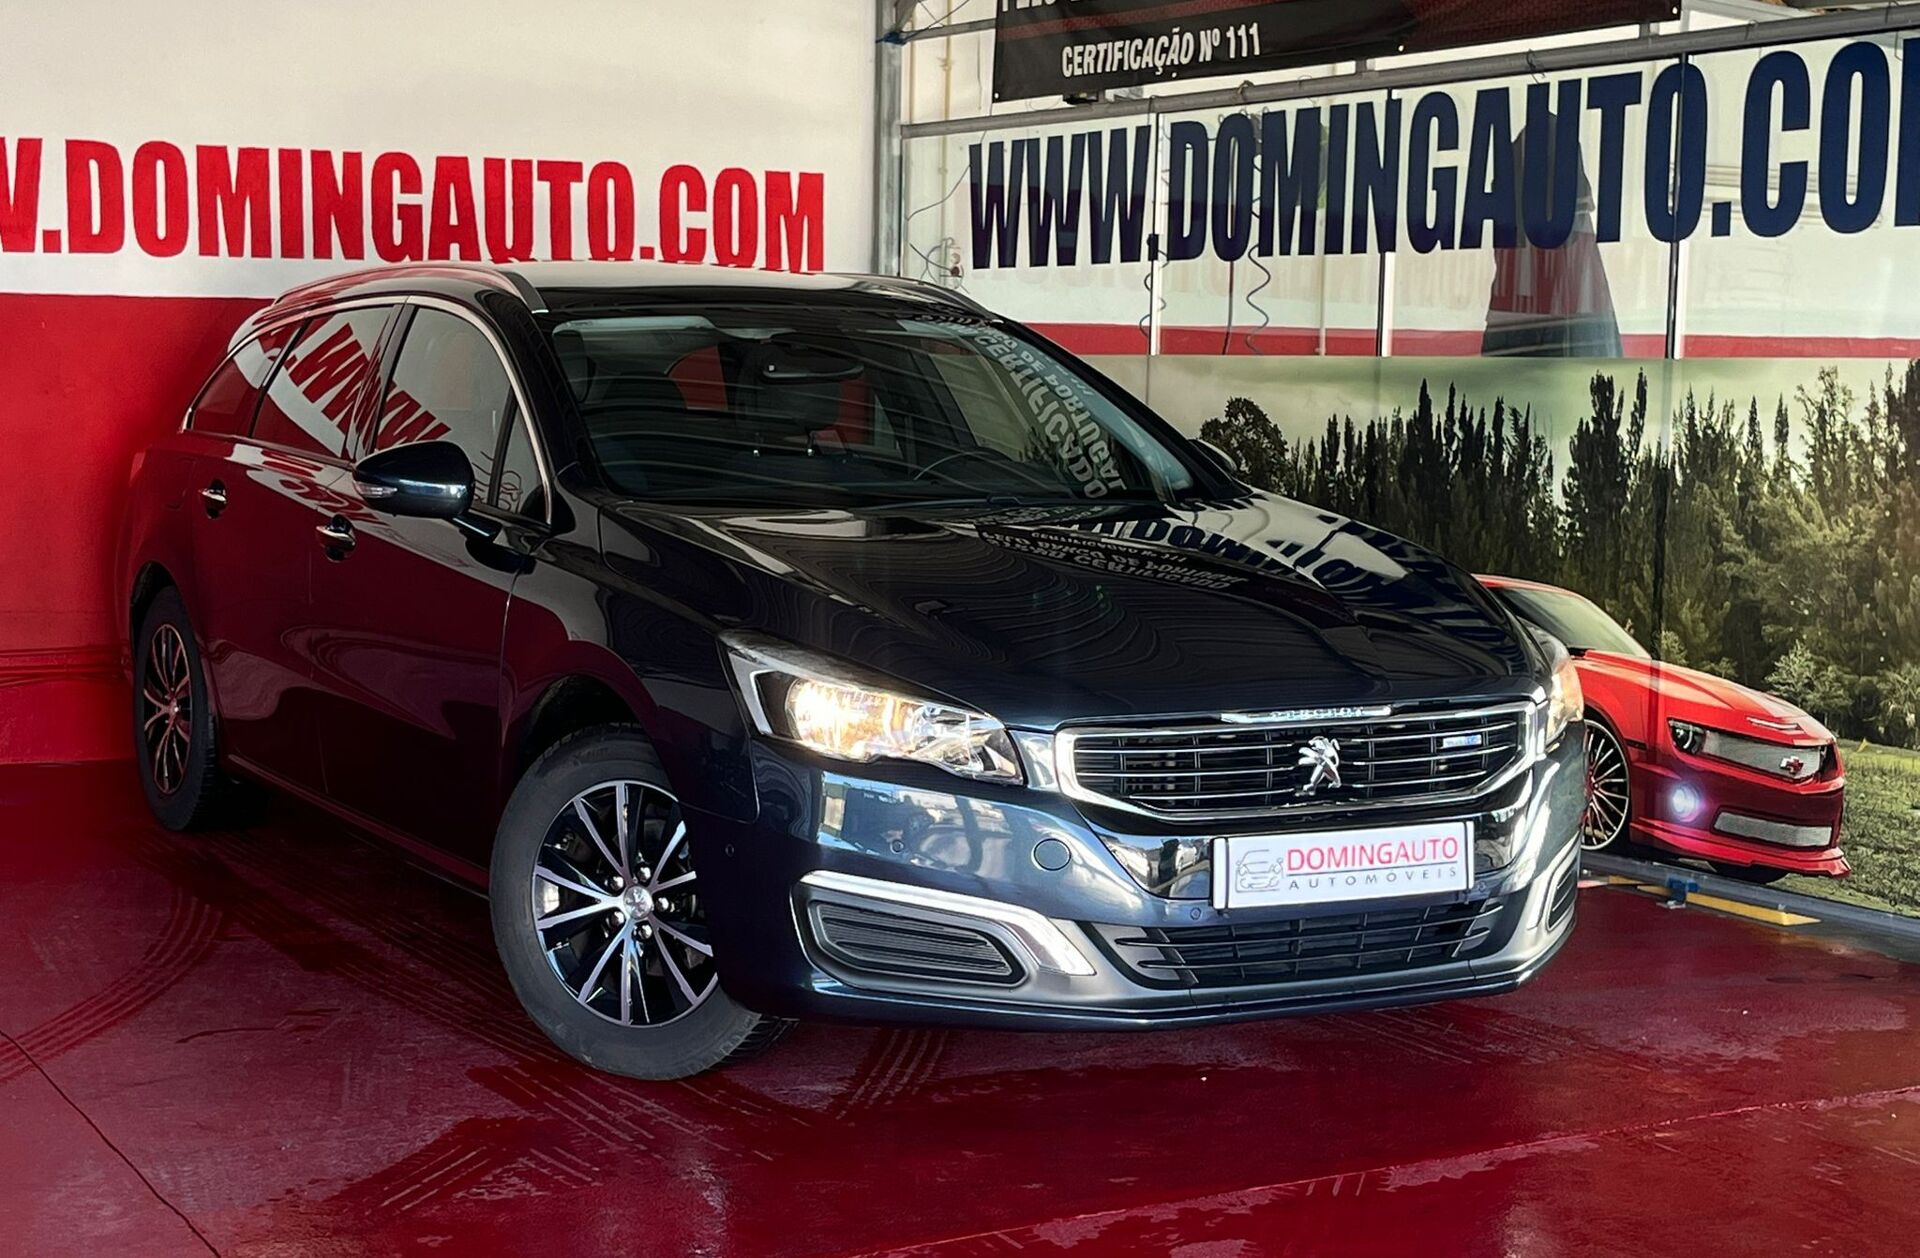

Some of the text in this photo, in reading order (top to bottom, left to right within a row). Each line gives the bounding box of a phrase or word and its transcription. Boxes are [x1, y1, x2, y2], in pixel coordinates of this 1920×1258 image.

[1062, 27, 1195, 77] CERTIFICAÇÃO
[1226, 22, 1260, 59] 111
[1287, 837, 1458, 871] DOMINGAUTO
